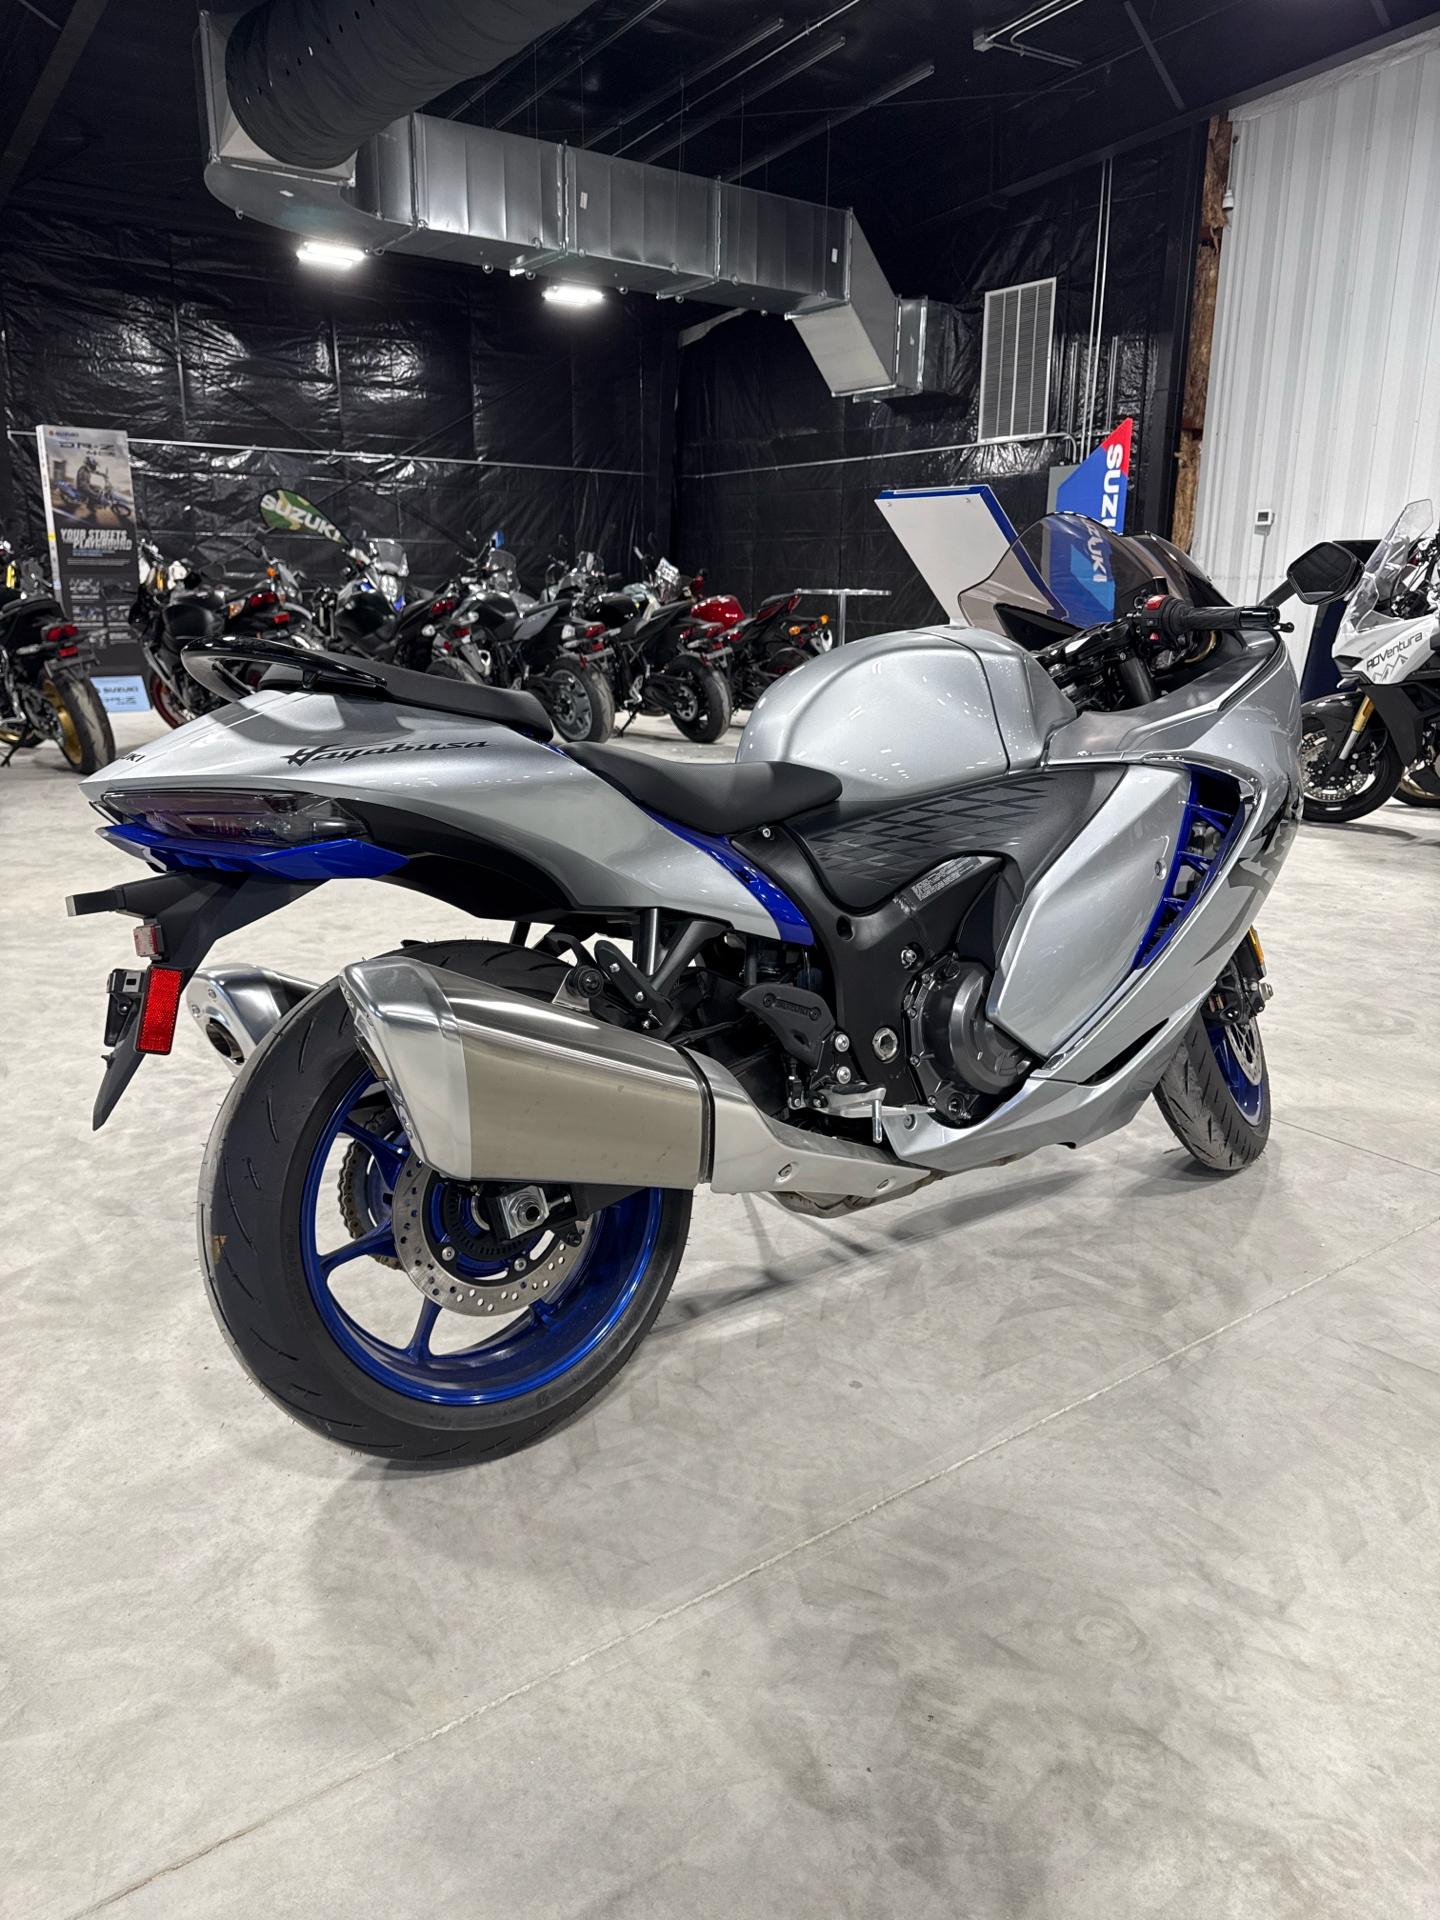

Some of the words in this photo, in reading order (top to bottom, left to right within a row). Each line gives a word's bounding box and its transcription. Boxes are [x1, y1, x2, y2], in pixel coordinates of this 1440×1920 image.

[260, 494, 342, 542] SUZUKI
[60, 528, 87, 541] YOUR
[88, 530, 128, 541] STREETS
[72, 539, 133, 551] PLAYGROUND
[280, 741, 490, 769] Hayabusa
[776, 1000, 809, 1016] SUZUKI
